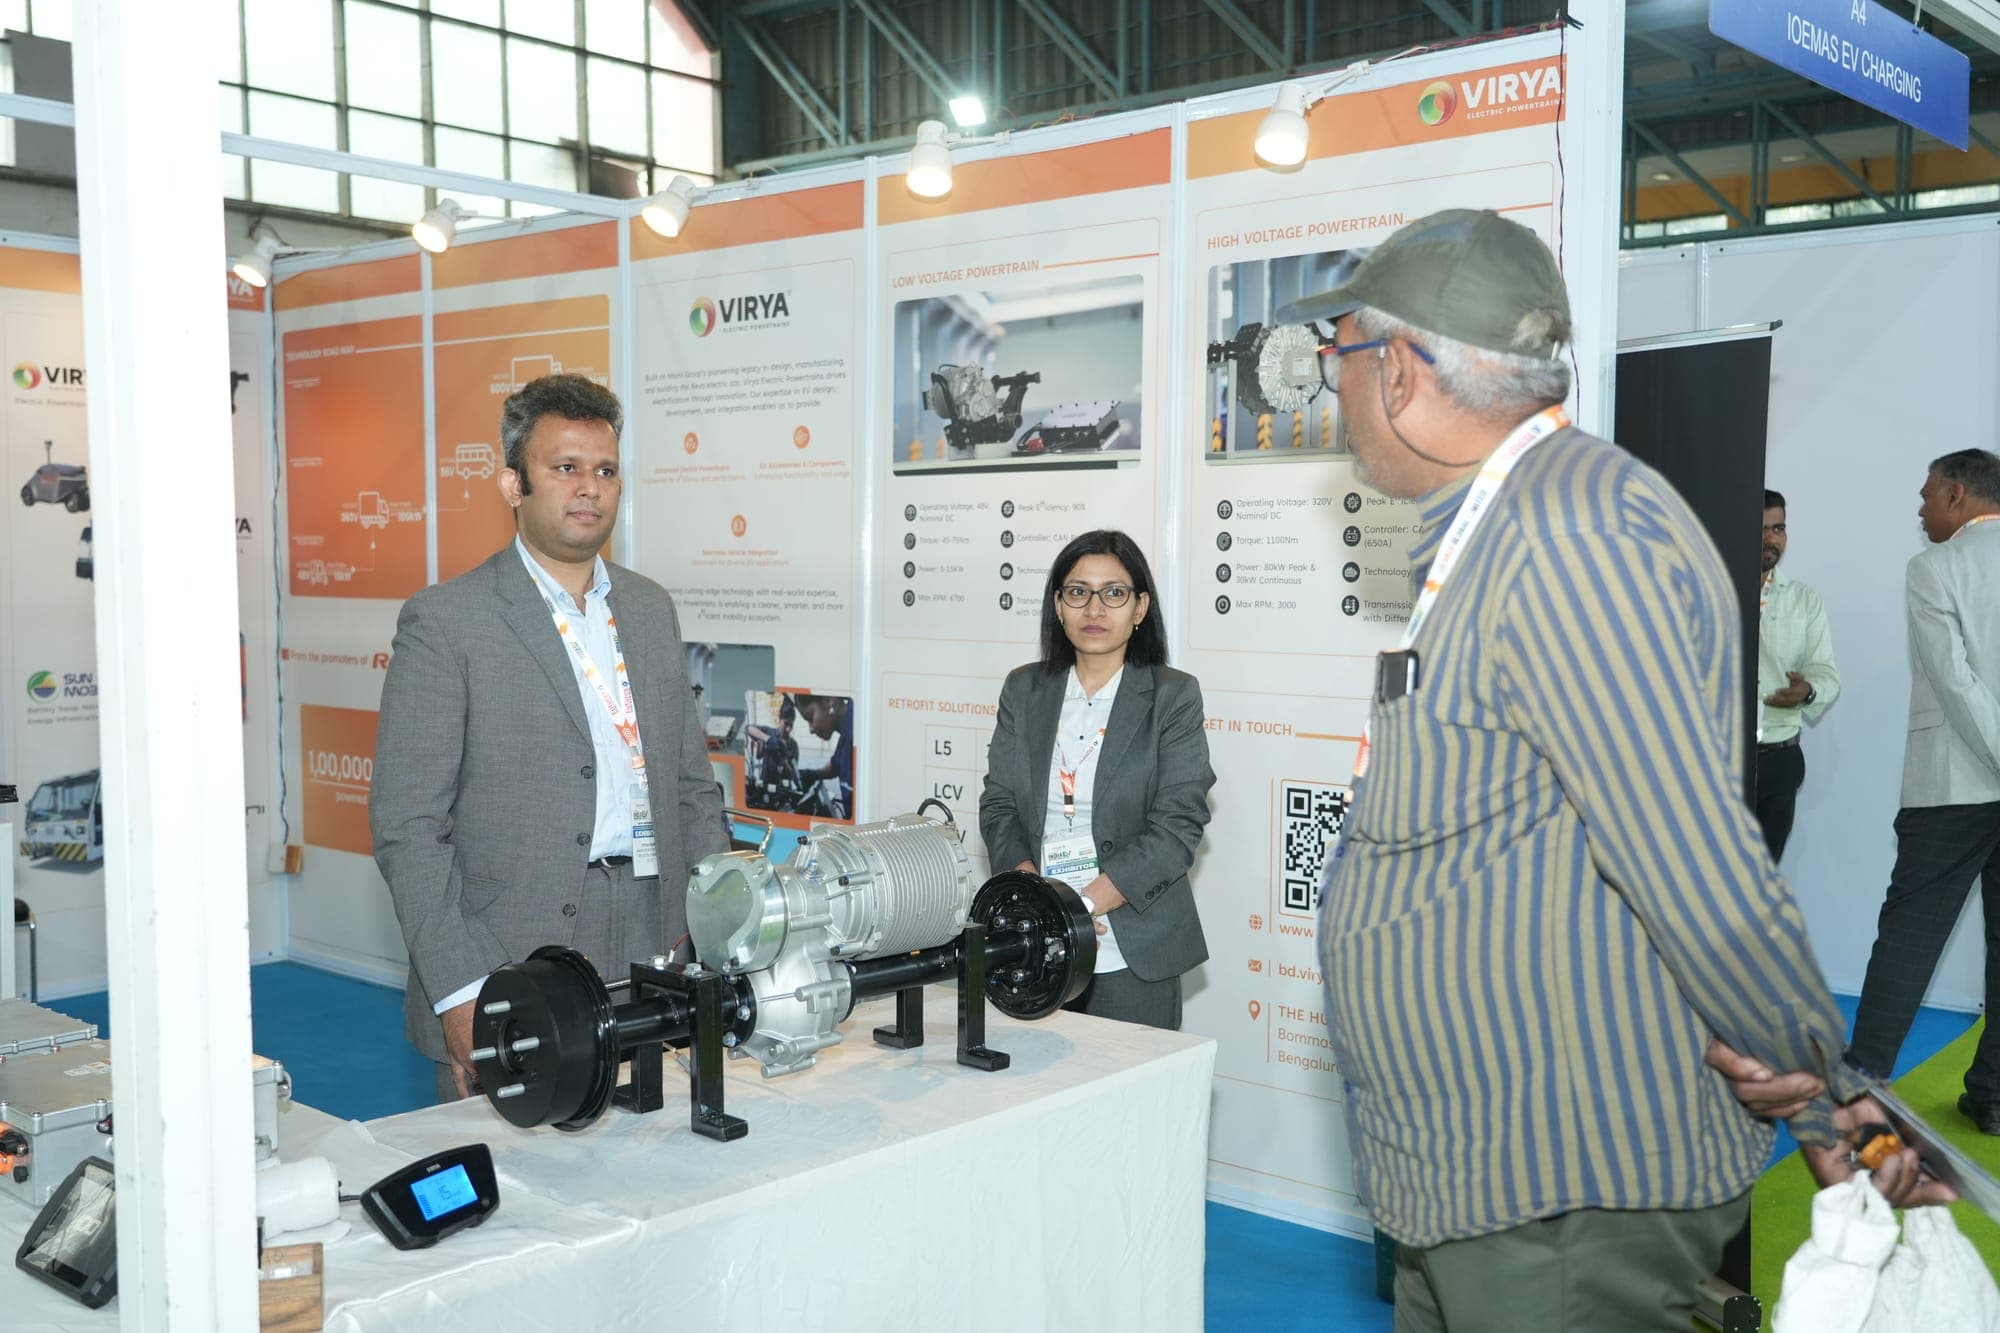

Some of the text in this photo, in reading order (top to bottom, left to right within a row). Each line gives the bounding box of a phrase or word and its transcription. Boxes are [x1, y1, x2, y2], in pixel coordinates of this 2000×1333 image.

[1850, 0, 1867, 26] A4
[1786, 11, 1922, 103] IOEMAS EV CHARGING
[1461, 66, 1564, 109] VIRYA
[1467, 108, 1504, 120] ELECTRIC
[1207, 212, 1404, 249] HIGH VOLTAGE POWERTRAIN
[892, 260, 1040, 288] LOW VOLTAGE POWERTRAIN
[719, 292, 789, 323] VIRYA
[44, 366, 86, 385] VIR
[1236, 497, 1333, 508] Operating Voltage: 320V
[1366, 497, 1387, 505] Peak
[1236, 511, 1282, 520] Nominal DC
[1364, 525, 1409, 534] Controller:
[1236, 536, 1299, 546] Torque: 1100Nm
[1363, 538, 1392, 548] (650A)
[1263, 563, 1286, 571] 80kW
[1288, 563, 1308, 571] Peak
[1310, 563, 1316, 571] &
[1364, 567, 1412, 578] Technology
[1235, 576, 1303, 585] 30kW Continuous
[1235, 600, 1252, 609] Max
[1277, 600, 1297, 609] 3000
[1363, 600, 1414, 610] Transmissio
[1363, 614, 1382, 623] with
[64, 673, 93, 684] SUN
[64, 685, 98, 697] MOB
[888, 698, 997, 716] RETROFIT SOLUTIONS
[1202, 718, 1292, 736] GET IN TOUCH
[935, 739, 953, 756] L5
[934, 782, 963, 801] LCV
[1279, 924, 1314, 938] www
[1278, 1005, 1328, 1026] THE HU
[1278, 1028, 1336, 1050] Bommas
